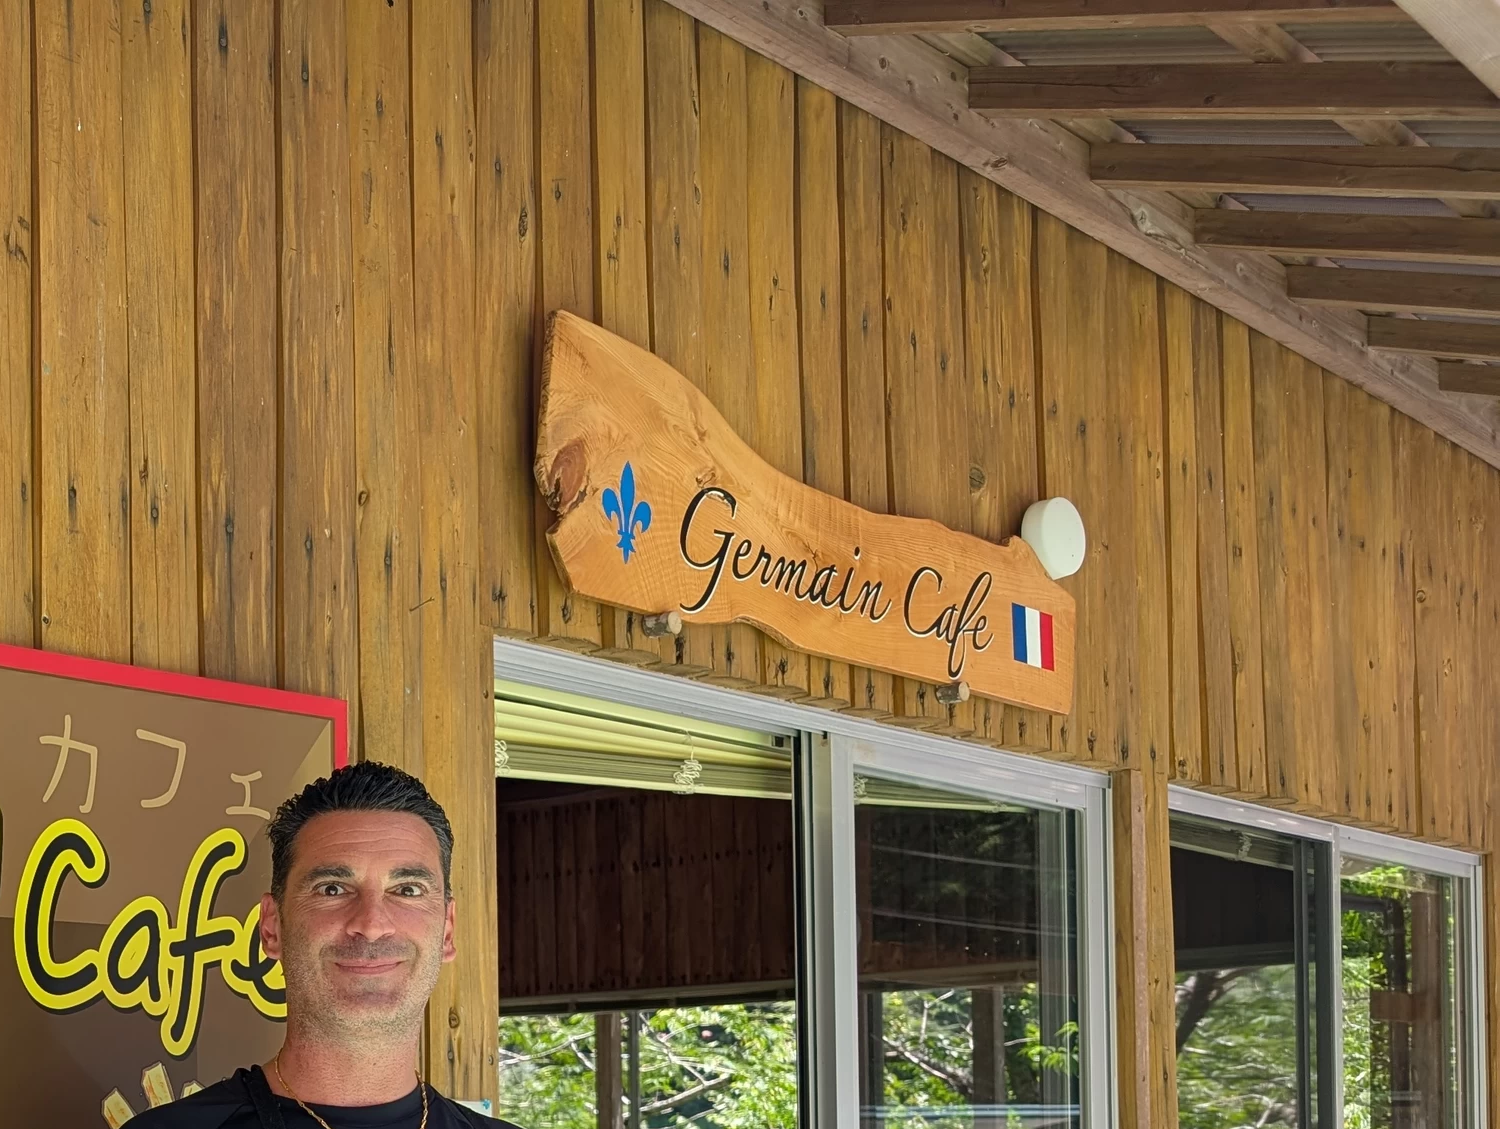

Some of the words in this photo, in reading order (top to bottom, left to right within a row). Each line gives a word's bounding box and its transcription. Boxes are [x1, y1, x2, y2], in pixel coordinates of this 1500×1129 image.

[680, 487, 892, 622] Germain
[903, 566, 995, 679] Cafe
[39, 714, 271, 820] カフェ
[14, 818, 288, 1057] Cafe
